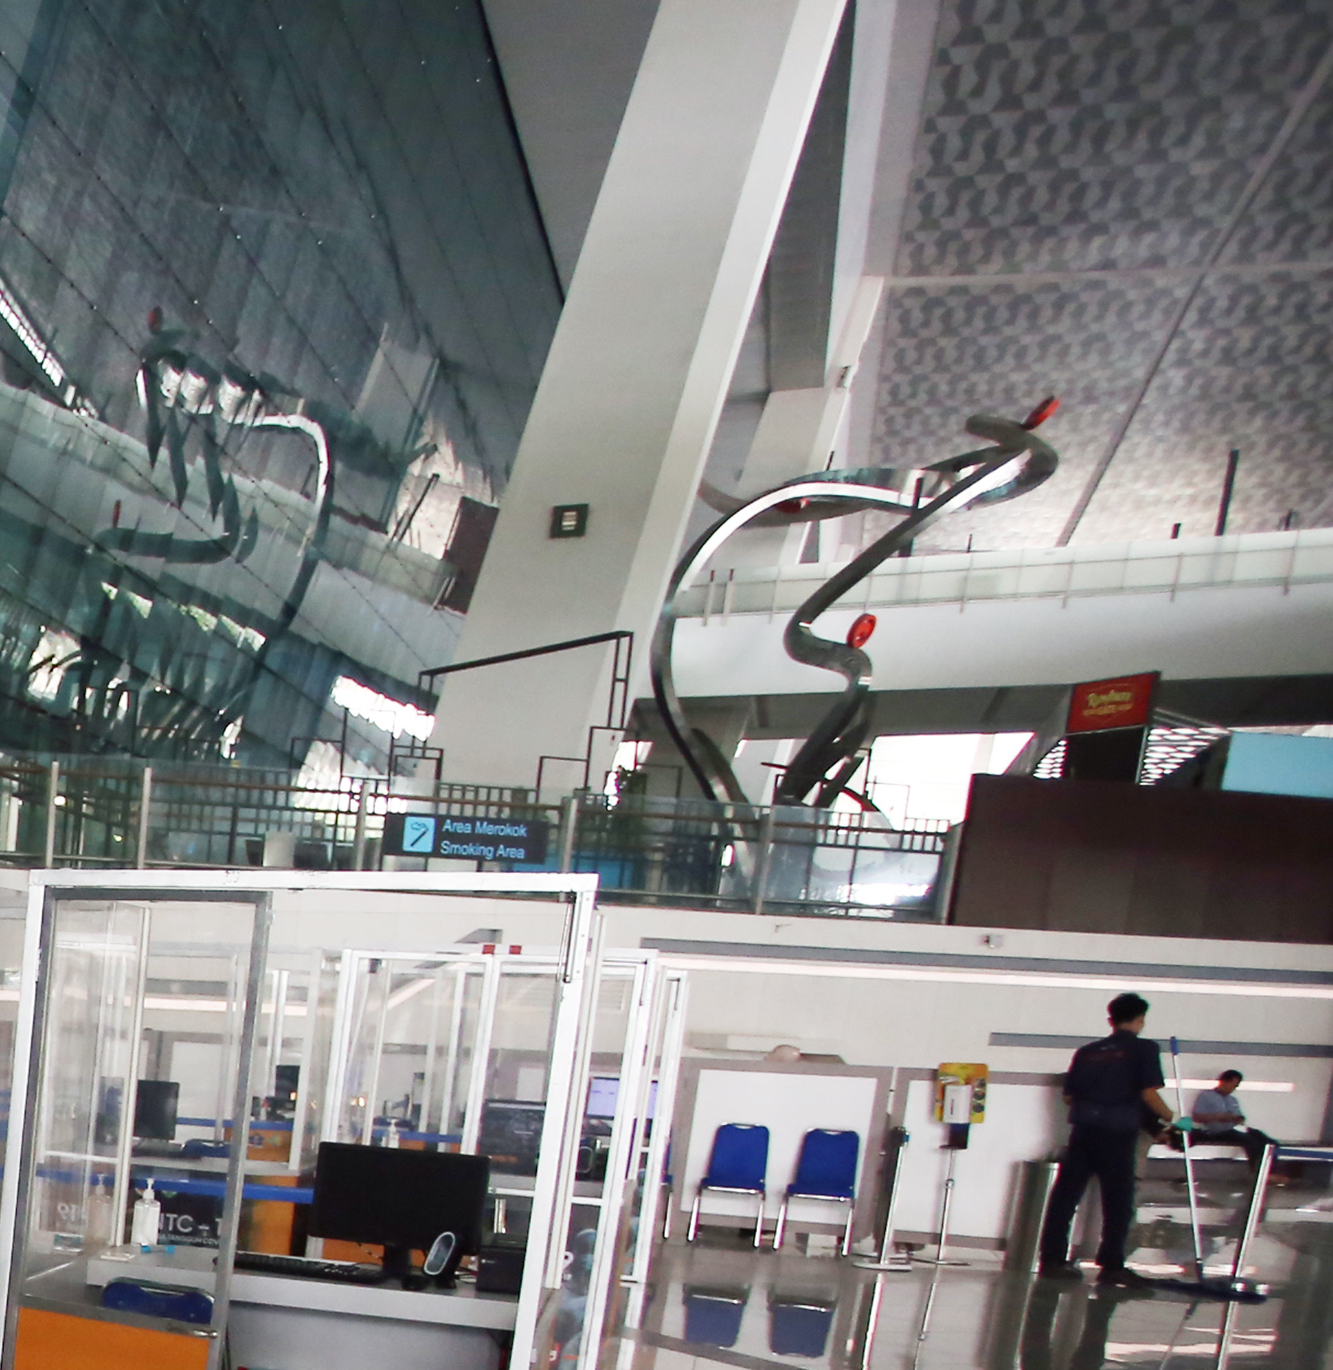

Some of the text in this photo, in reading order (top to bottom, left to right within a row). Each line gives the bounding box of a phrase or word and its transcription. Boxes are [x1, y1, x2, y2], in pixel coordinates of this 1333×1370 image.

[442, 819, 528, 838] Area Merokok
[440, 841, 525, 860] Smoking Area
